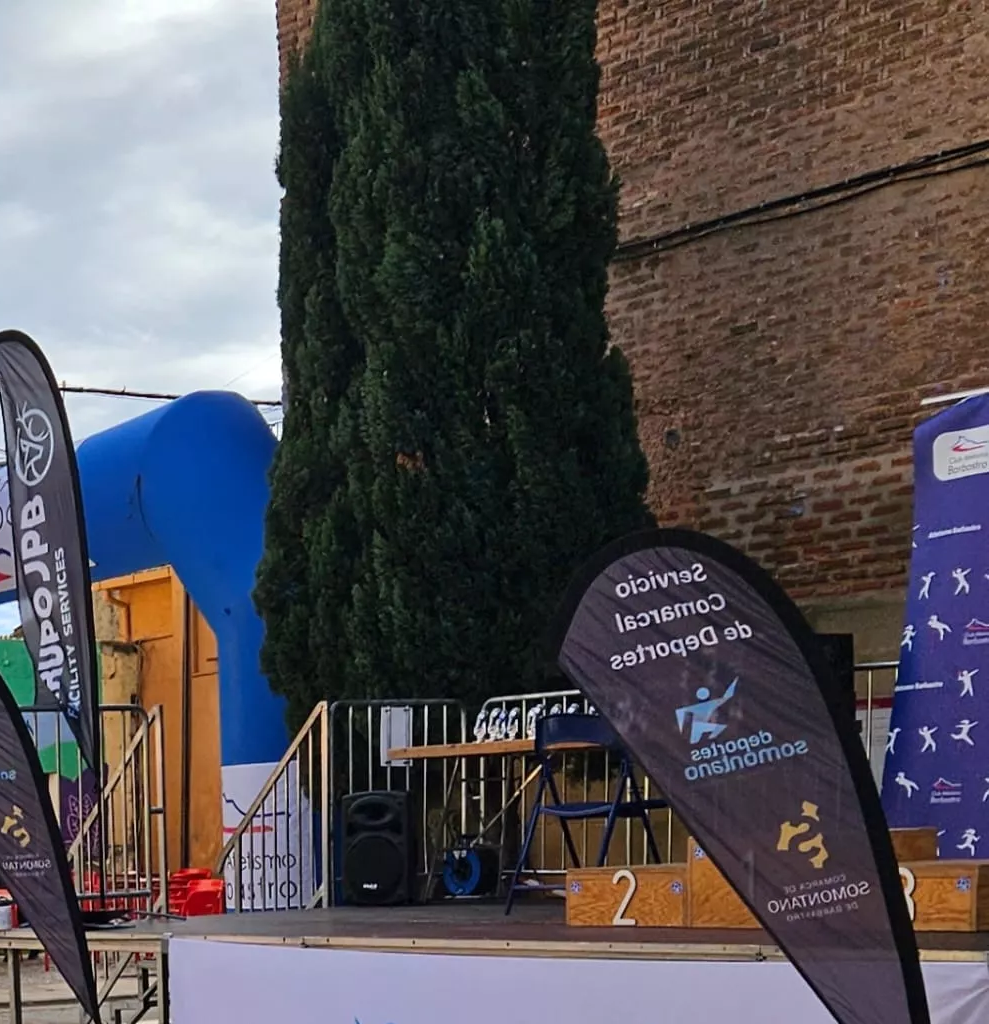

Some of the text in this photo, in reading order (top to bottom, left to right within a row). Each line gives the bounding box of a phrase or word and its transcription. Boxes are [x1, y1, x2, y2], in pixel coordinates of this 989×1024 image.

[20, 493, 65, 701] RUPO JPB
[55, 547, 81, 720] FACILITY SERVICES
[612, 869, 637, 926] 2
